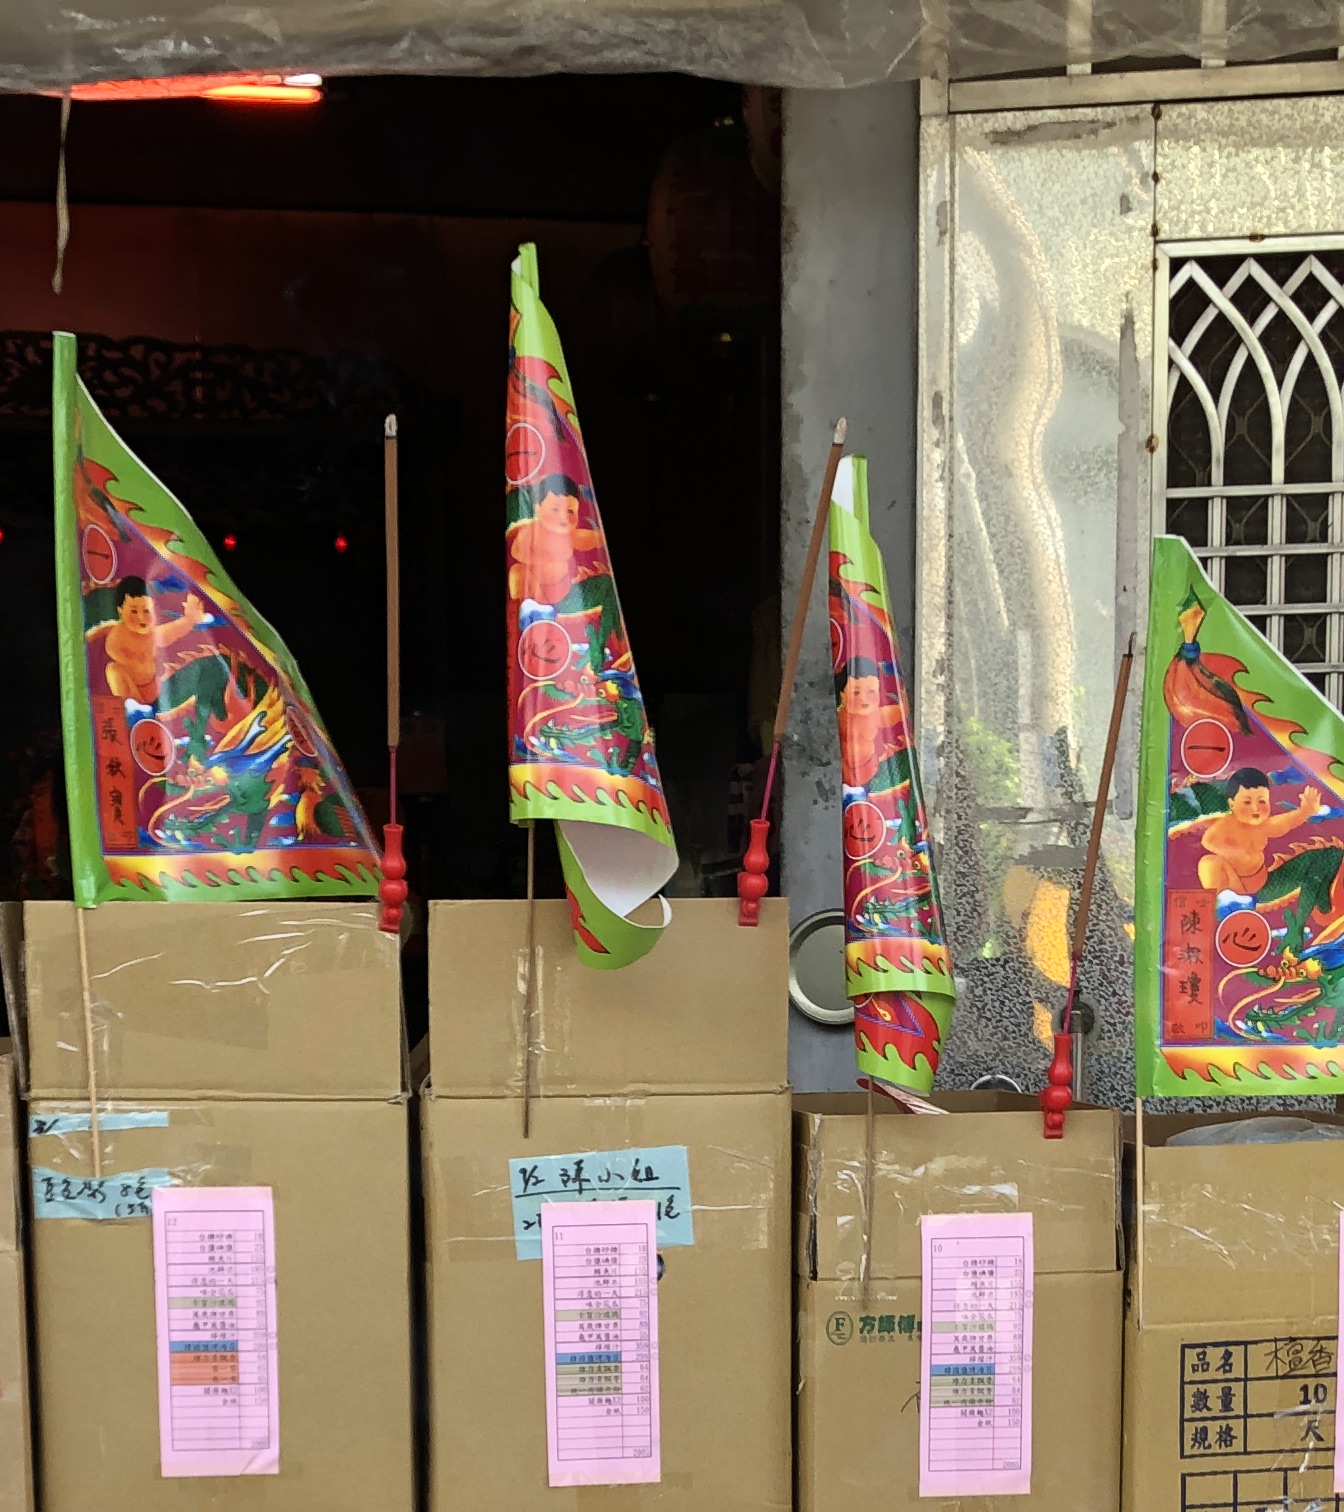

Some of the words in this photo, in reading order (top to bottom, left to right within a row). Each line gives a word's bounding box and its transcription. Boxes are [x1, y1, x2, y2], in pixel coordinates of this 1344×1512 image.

[135, 734, 167, 762] 心
[1221, 926, 1263, 952] 心
[834, 1317, 846, 1332] F
[1190, 1347, 1235, 1374] 品名
[1189, 1385, 1238, 1414] 數量
[1298, 1382, 1329, 1406] 10
[1189, 1422, 1238, 1451] 規格
